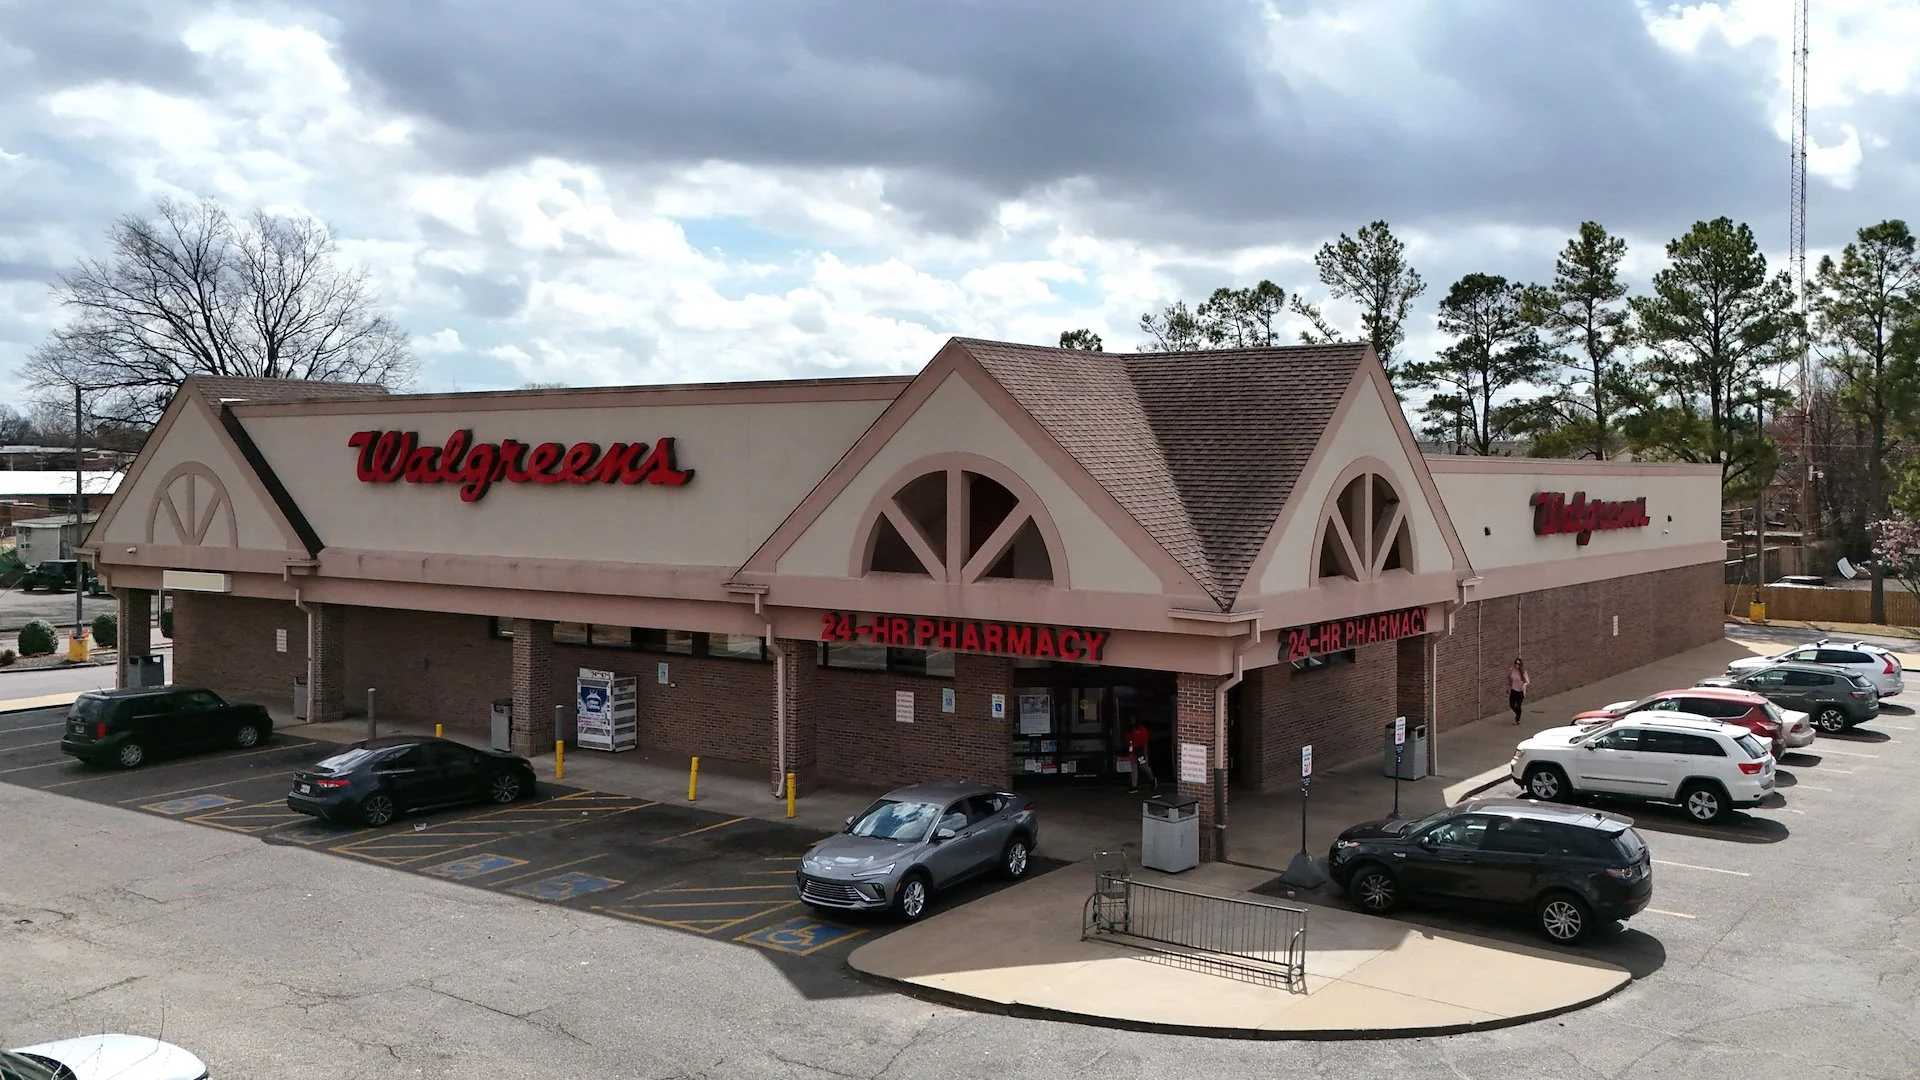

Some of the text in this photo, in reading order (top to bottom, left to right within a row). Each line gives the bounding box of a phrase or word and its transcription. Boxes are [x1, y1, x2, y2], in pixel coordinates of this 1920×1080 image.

[348, 428, 695, 502] Walgreens
[821, 613, 1106, 661] 24-HR PHARMACY
[1286, 607, 1429, 661] 24-HR PHARMACY
